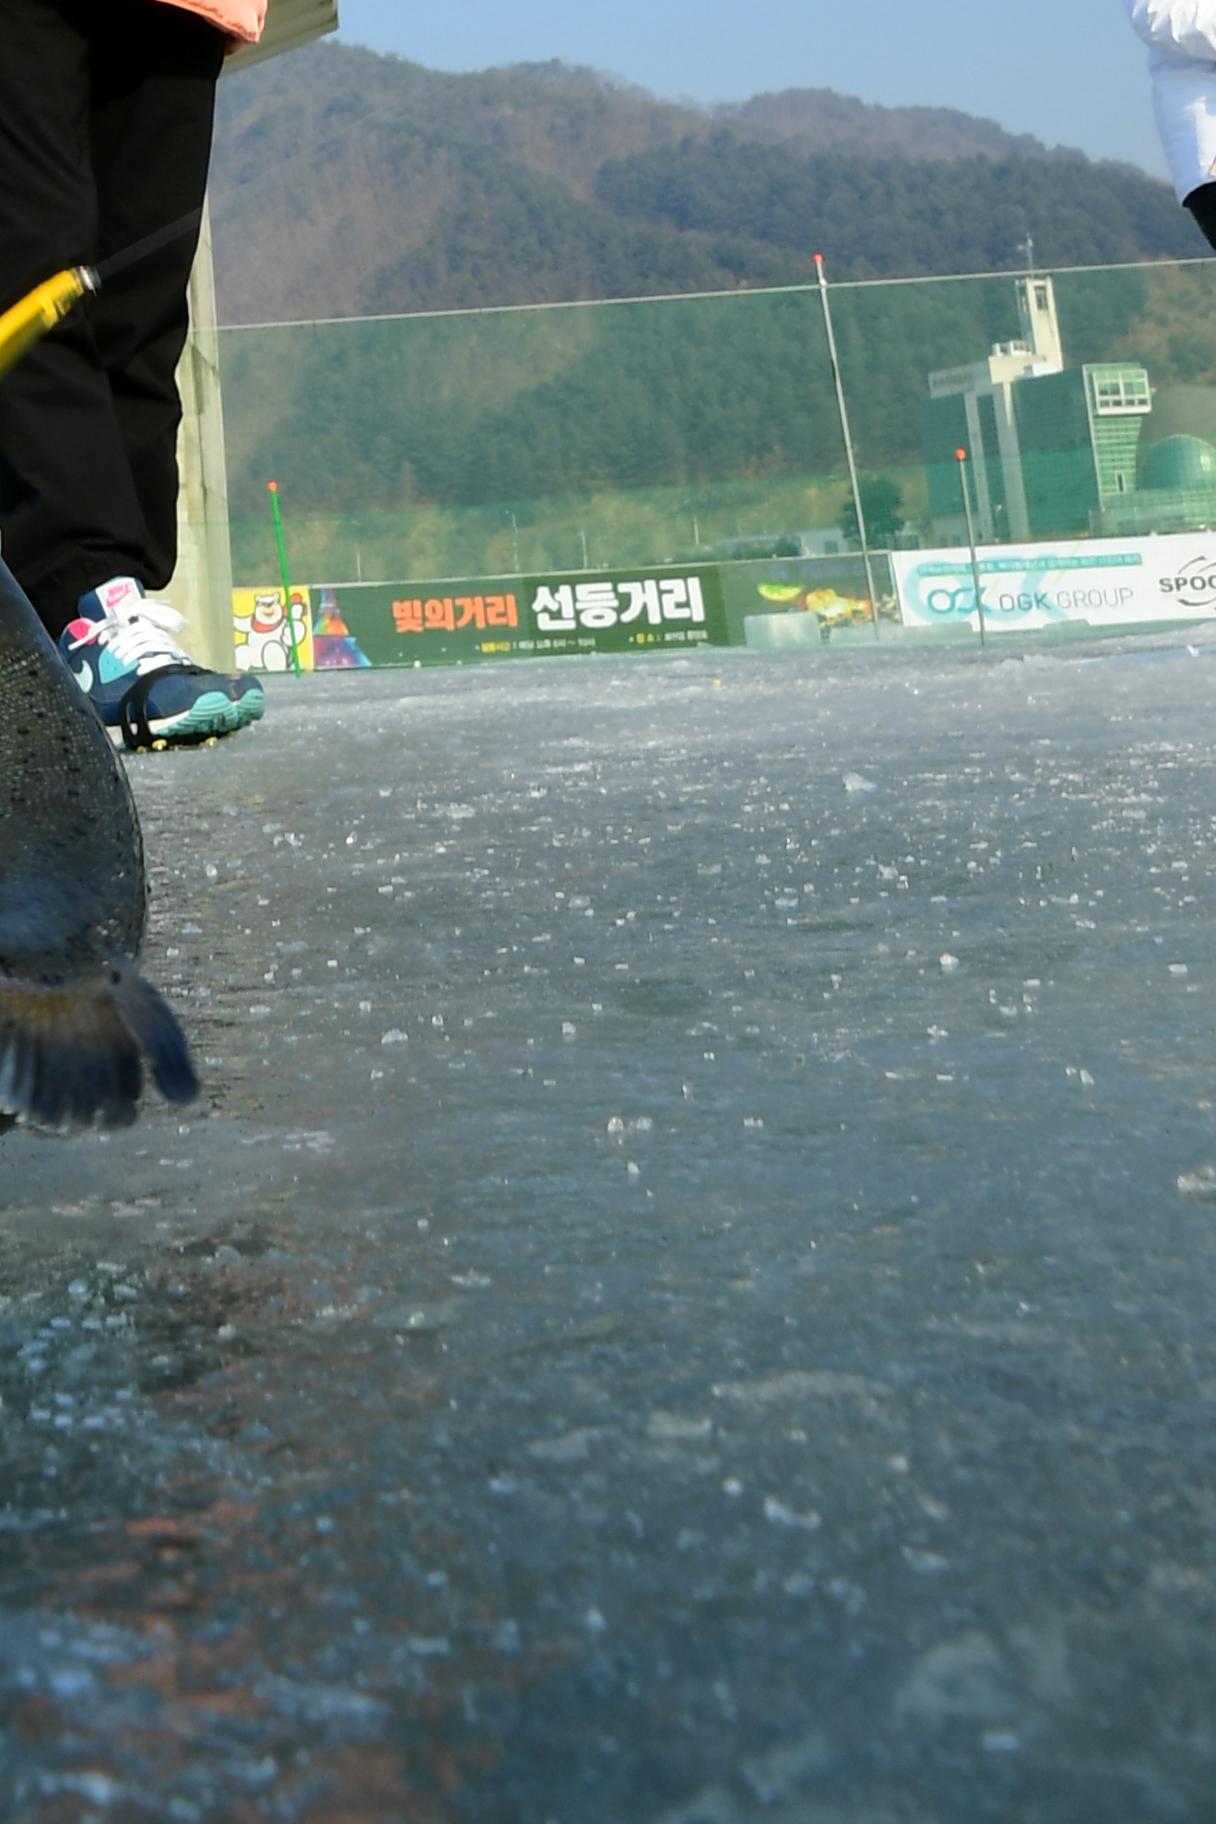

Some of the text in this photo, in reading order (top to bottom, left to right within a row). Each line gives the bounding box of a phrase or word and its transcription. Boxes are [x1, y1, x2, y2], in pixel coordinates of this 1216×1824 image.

[392, 576, 705, 633] 빛의거리 선등거리
[999, 592, 1051, 613] OGK
[1056, 587, 1134, 609] GROUP
